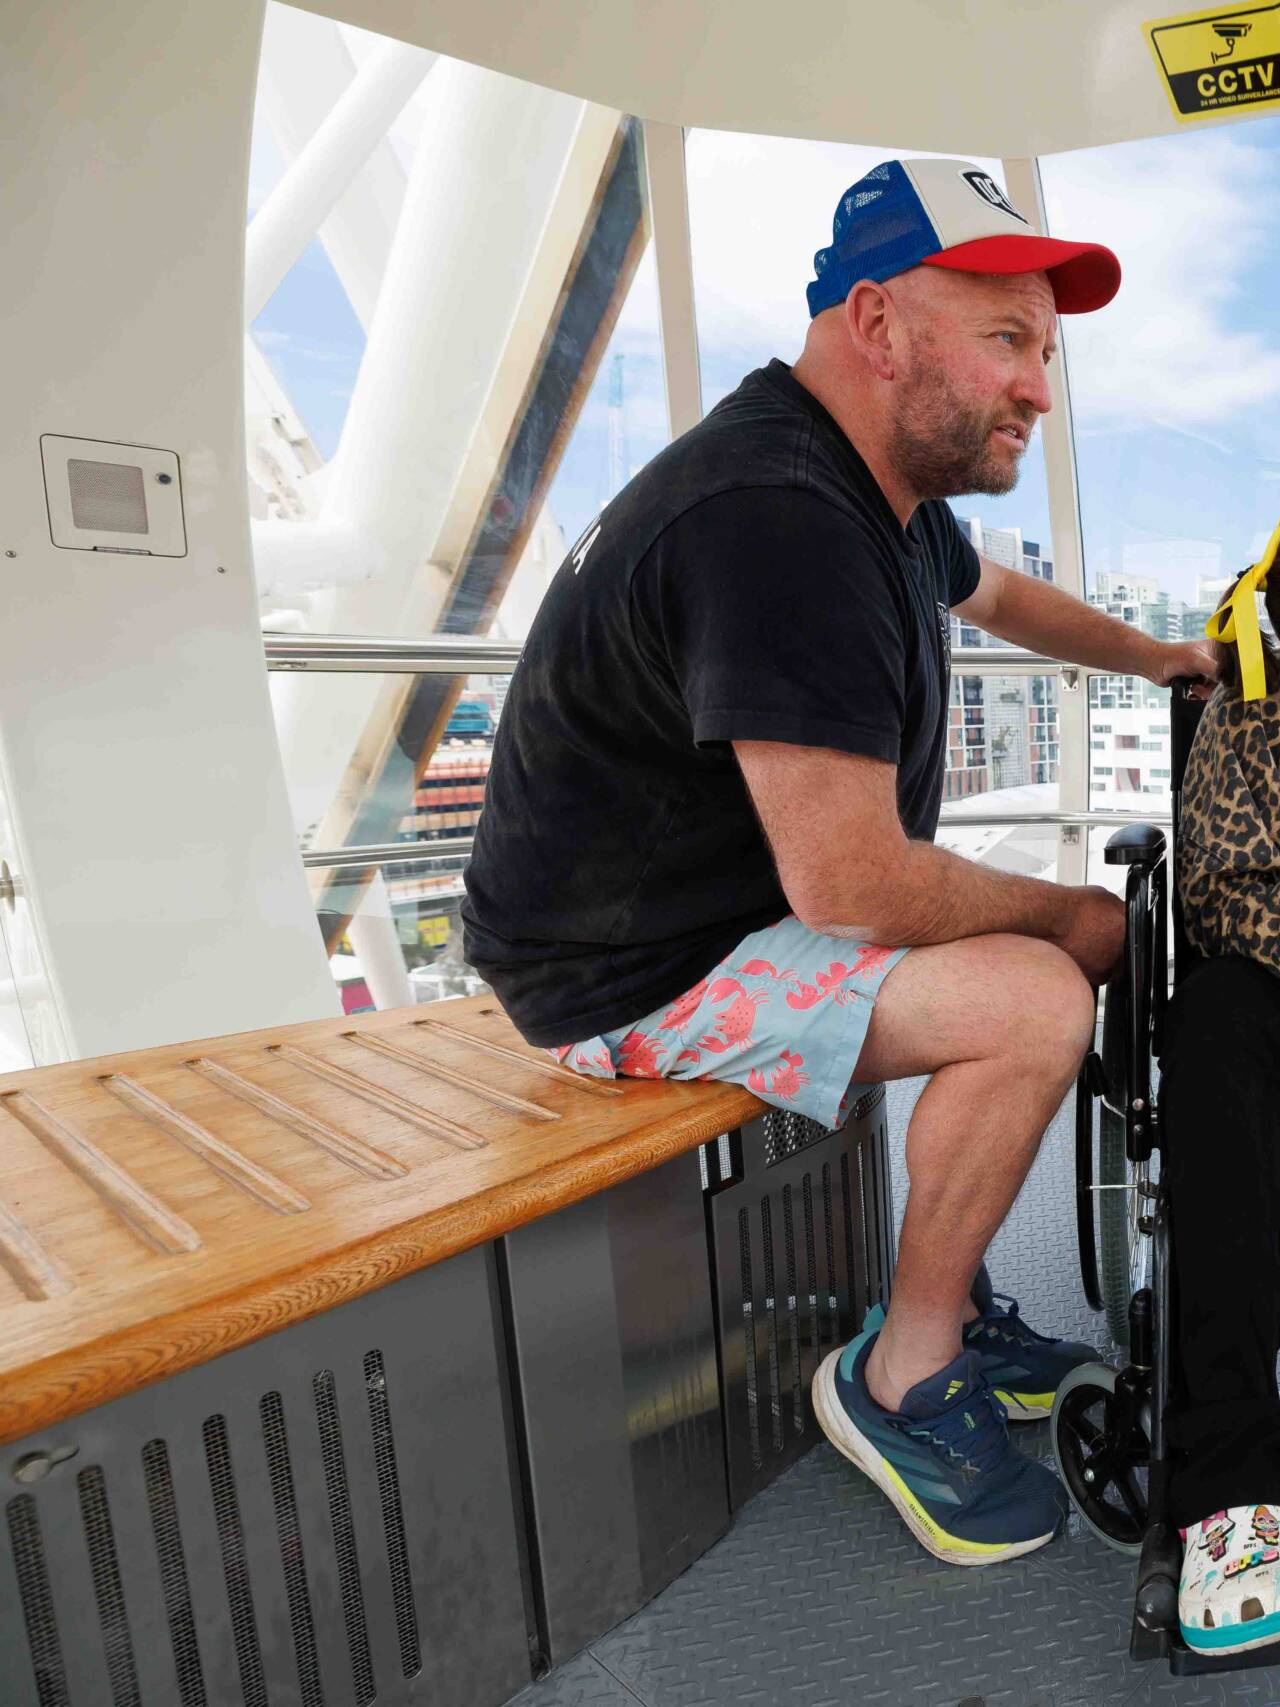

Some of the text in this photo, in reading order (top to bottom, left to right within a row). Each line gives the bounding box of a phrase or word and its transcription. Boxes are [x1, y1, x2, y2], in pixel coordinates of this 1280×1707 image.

[1197, 62, 1274, 97] CCTV
[1208, 96, 1218, 106] HR
[1218, 94, 1237, 104] VIDEO
